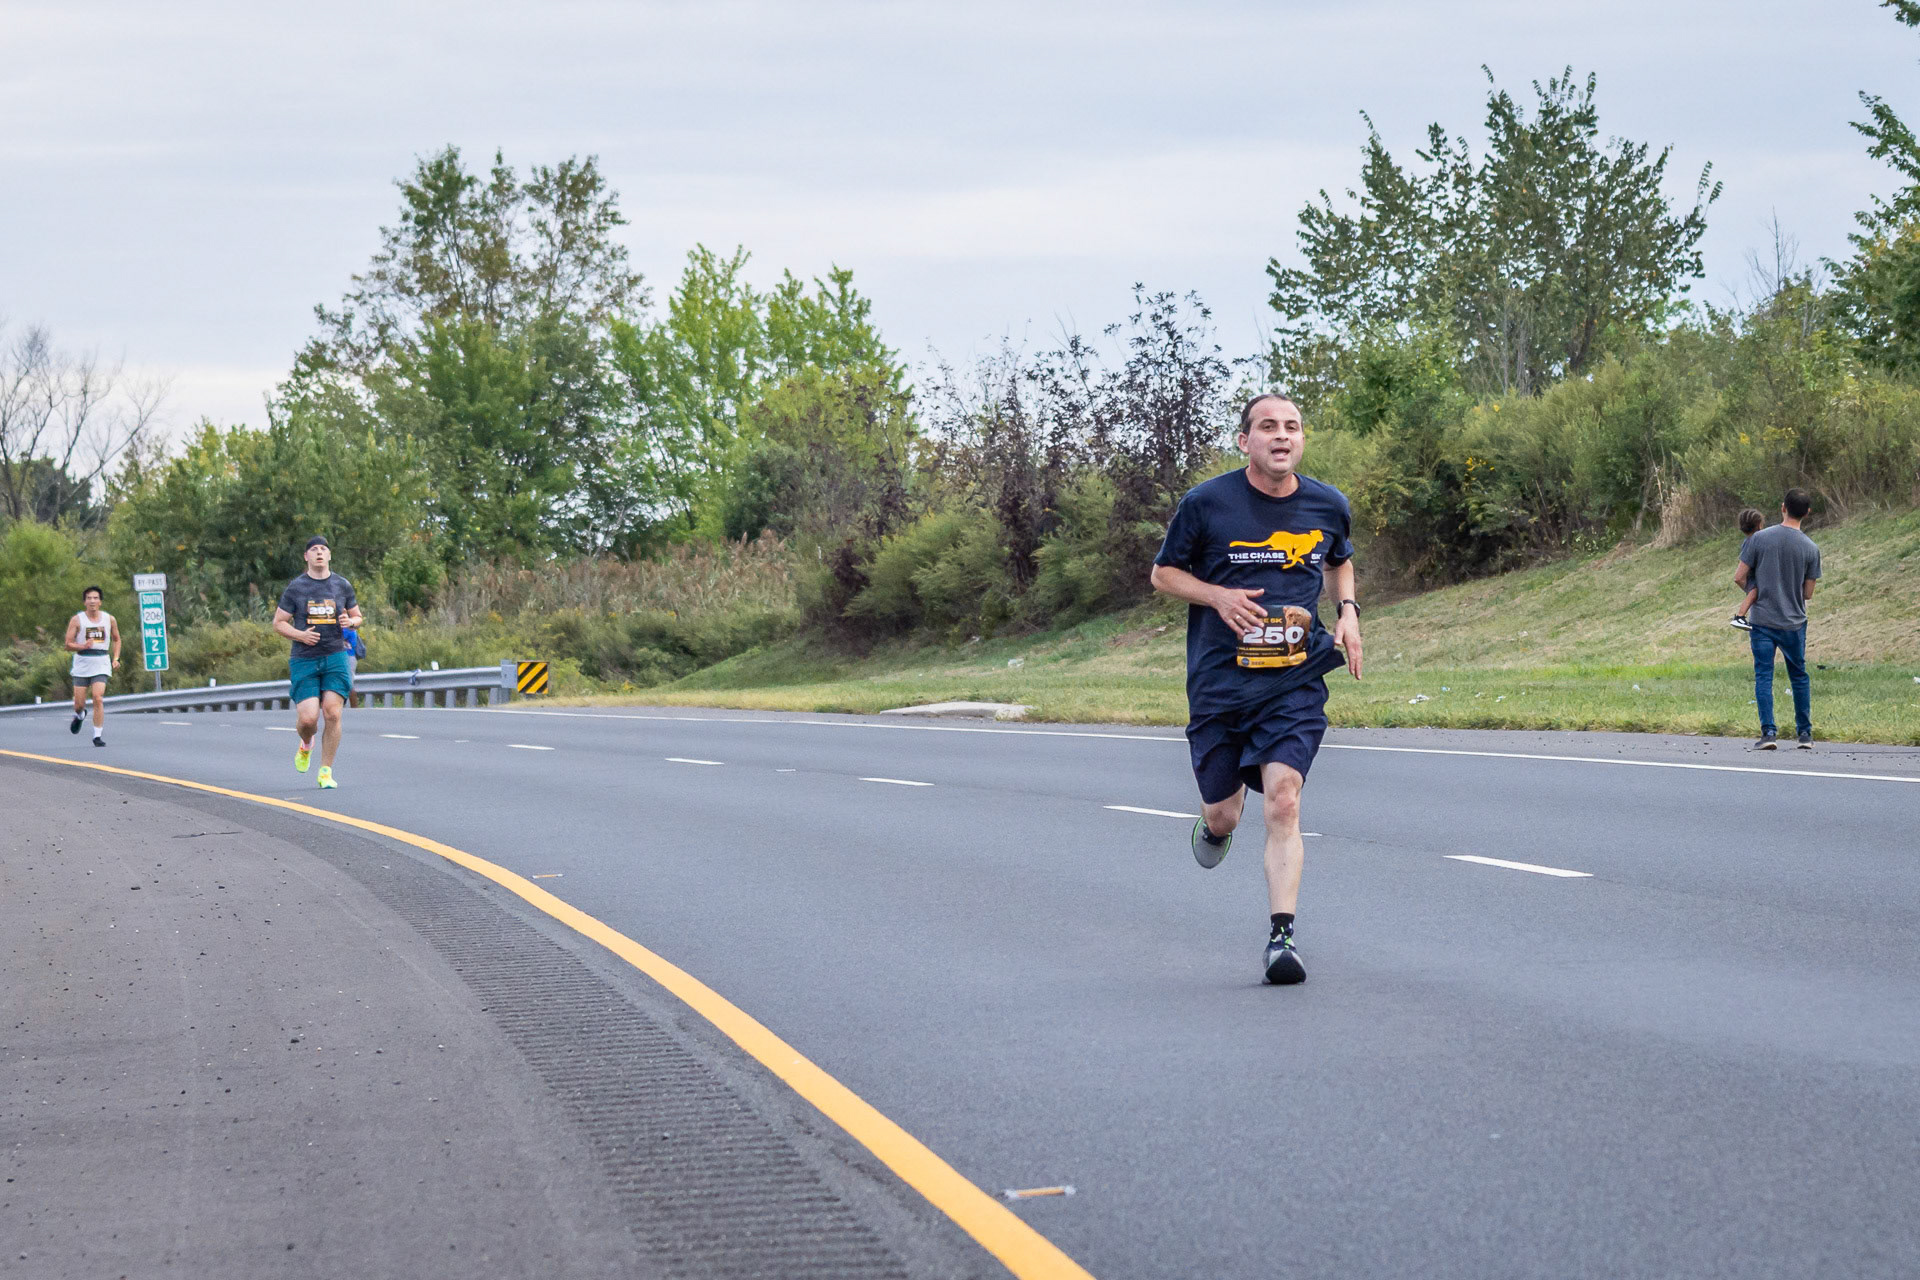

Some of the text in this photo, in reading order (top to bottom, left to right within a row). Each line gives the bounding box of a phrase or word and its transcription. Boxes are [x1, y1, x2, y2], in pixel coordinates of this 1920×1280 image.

[143, 595, 162, 605] SOUTH
[145, 611, 162, 621] 206
[145, 628, 164, 638] MILE
[1243, 626, 1304, 645] 250
[151, 639, 159, 652] 2
